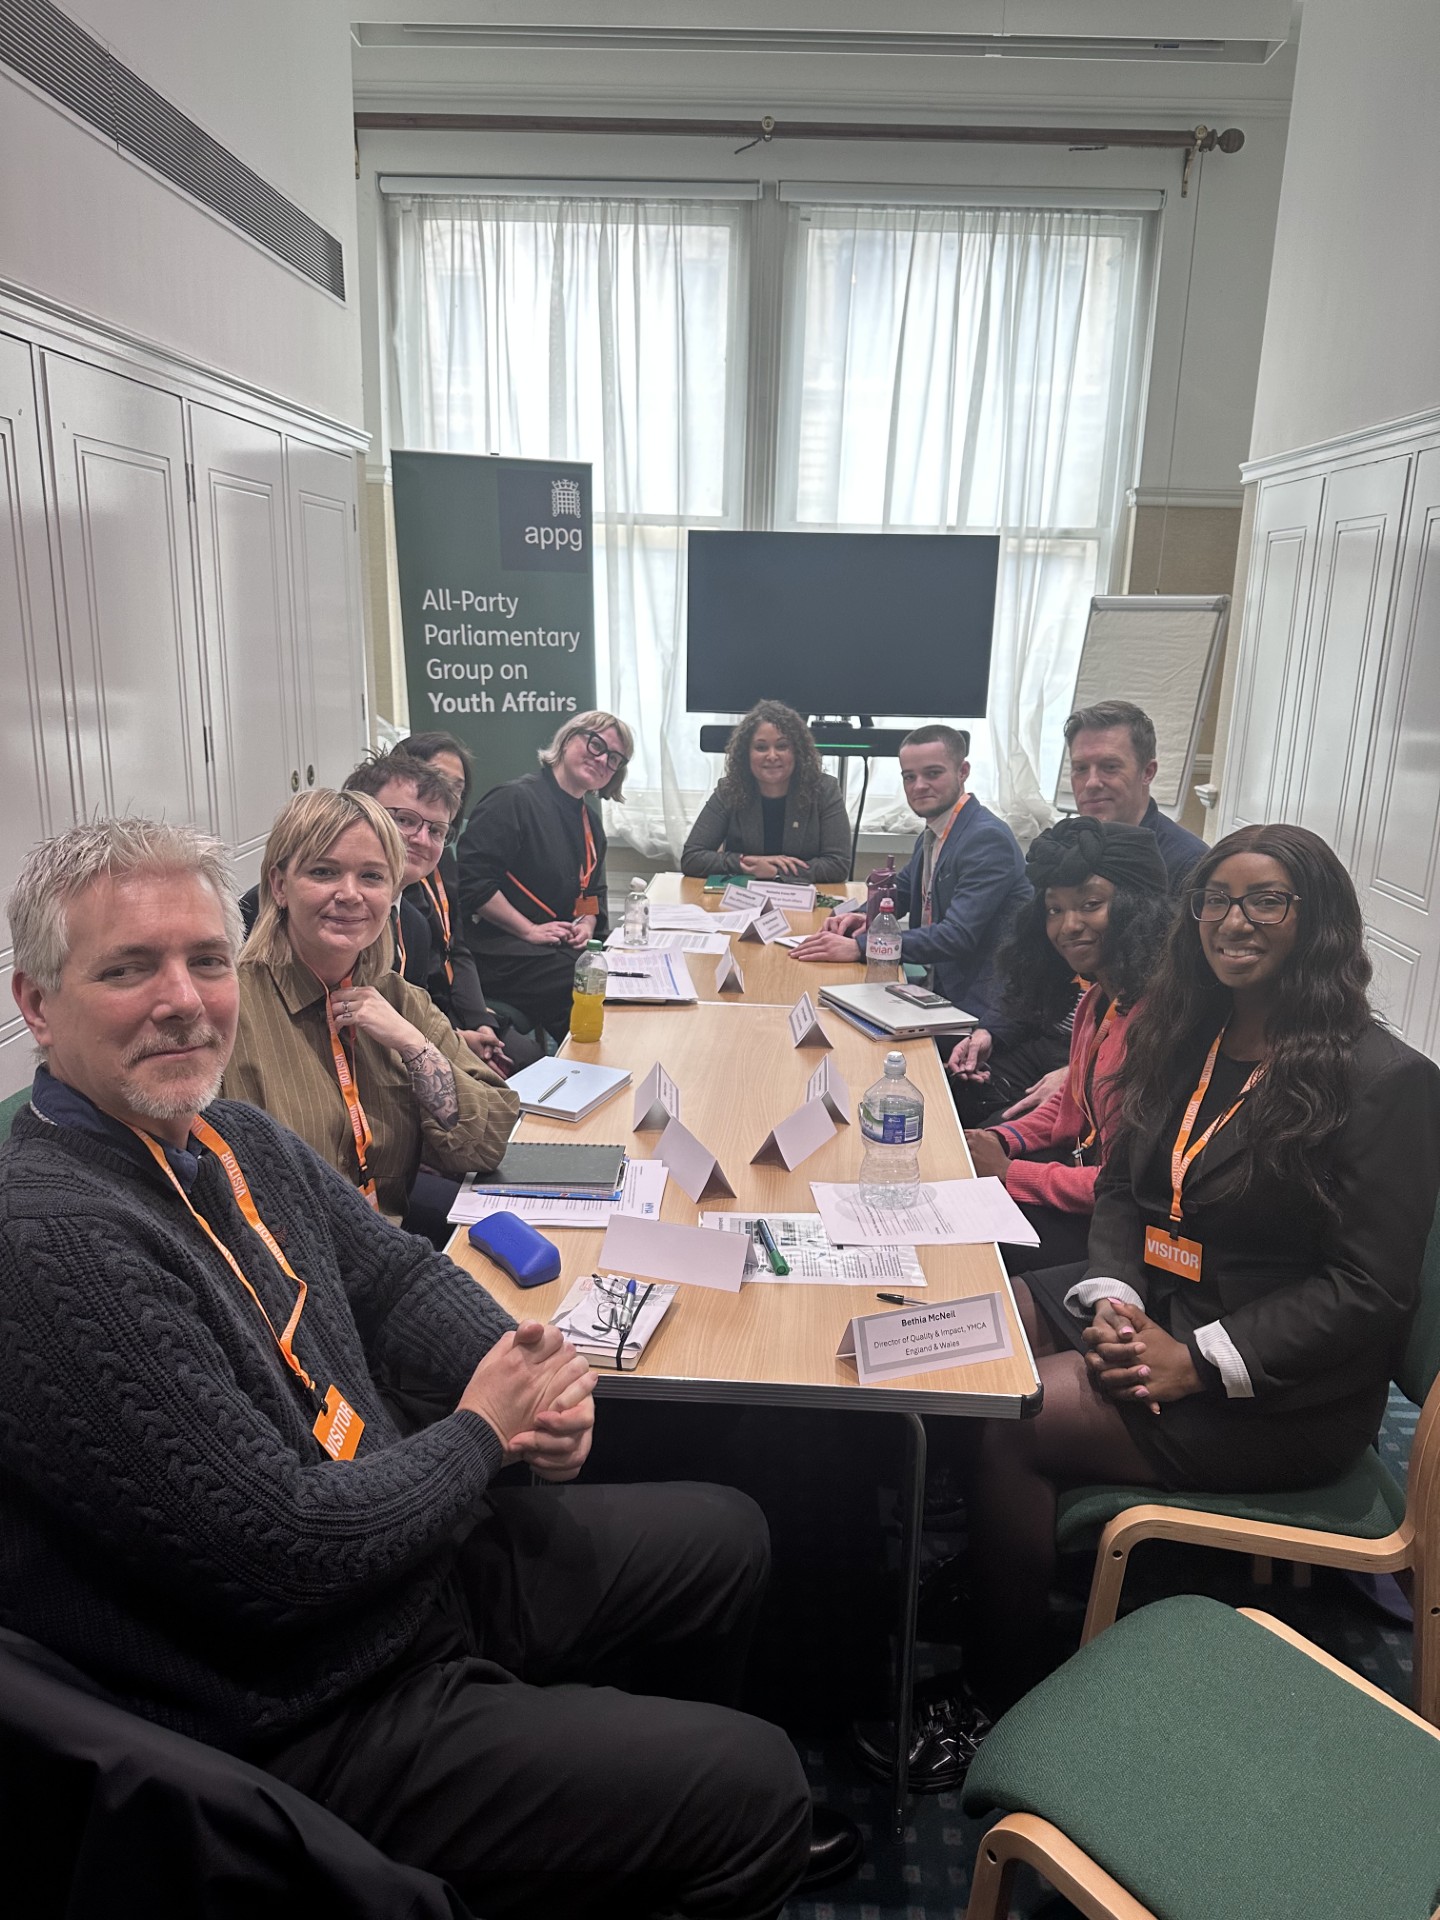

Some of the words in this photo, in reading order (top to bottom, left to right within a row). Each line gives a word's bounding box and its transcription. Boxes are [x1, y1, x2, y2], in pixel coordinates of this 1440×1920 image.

[524, 526, 582, 551] appg
[422, 589, 519, 618] All-Party
[424, 624, 580, 652] Parliamentary
[426, 658, 493, 685] Group
[500, 661, 528, 680] on
[428, 691, 495, 713] Youth
[501, 691, 577, 713] Affairs
[869, 945, 893, 954] evian
[334, 1052, 351, 1087] VISITOR
[348, 1104, 362, 1138] VISITOR
[1182, 1100, 1200, 1131] VISITOR
[221, 1150, 247, 1199] VISITOR
[255, 1222, 285, 1266] VISITOR
[1146, 1238, 1200, 1269] VISITOR
[901, 1316, 927, 1327] Bethia
[928, 1310, 956, 1323] McNeil
[873, 1337, 901, 1349] Director
[902, 1335, 910, 1344] of
[910, 1331, 934, 1343] Quality
[934, 1329, 940, 1338] &
[941, 1326, 967, 1339] Impact,
[966, 1321, 987, 1332] YMCA
[905, 1346, 932, 1356] England
[939, 1340, 960, 1350] Wales
[324, 1400, 354, 1458] VISITOR
